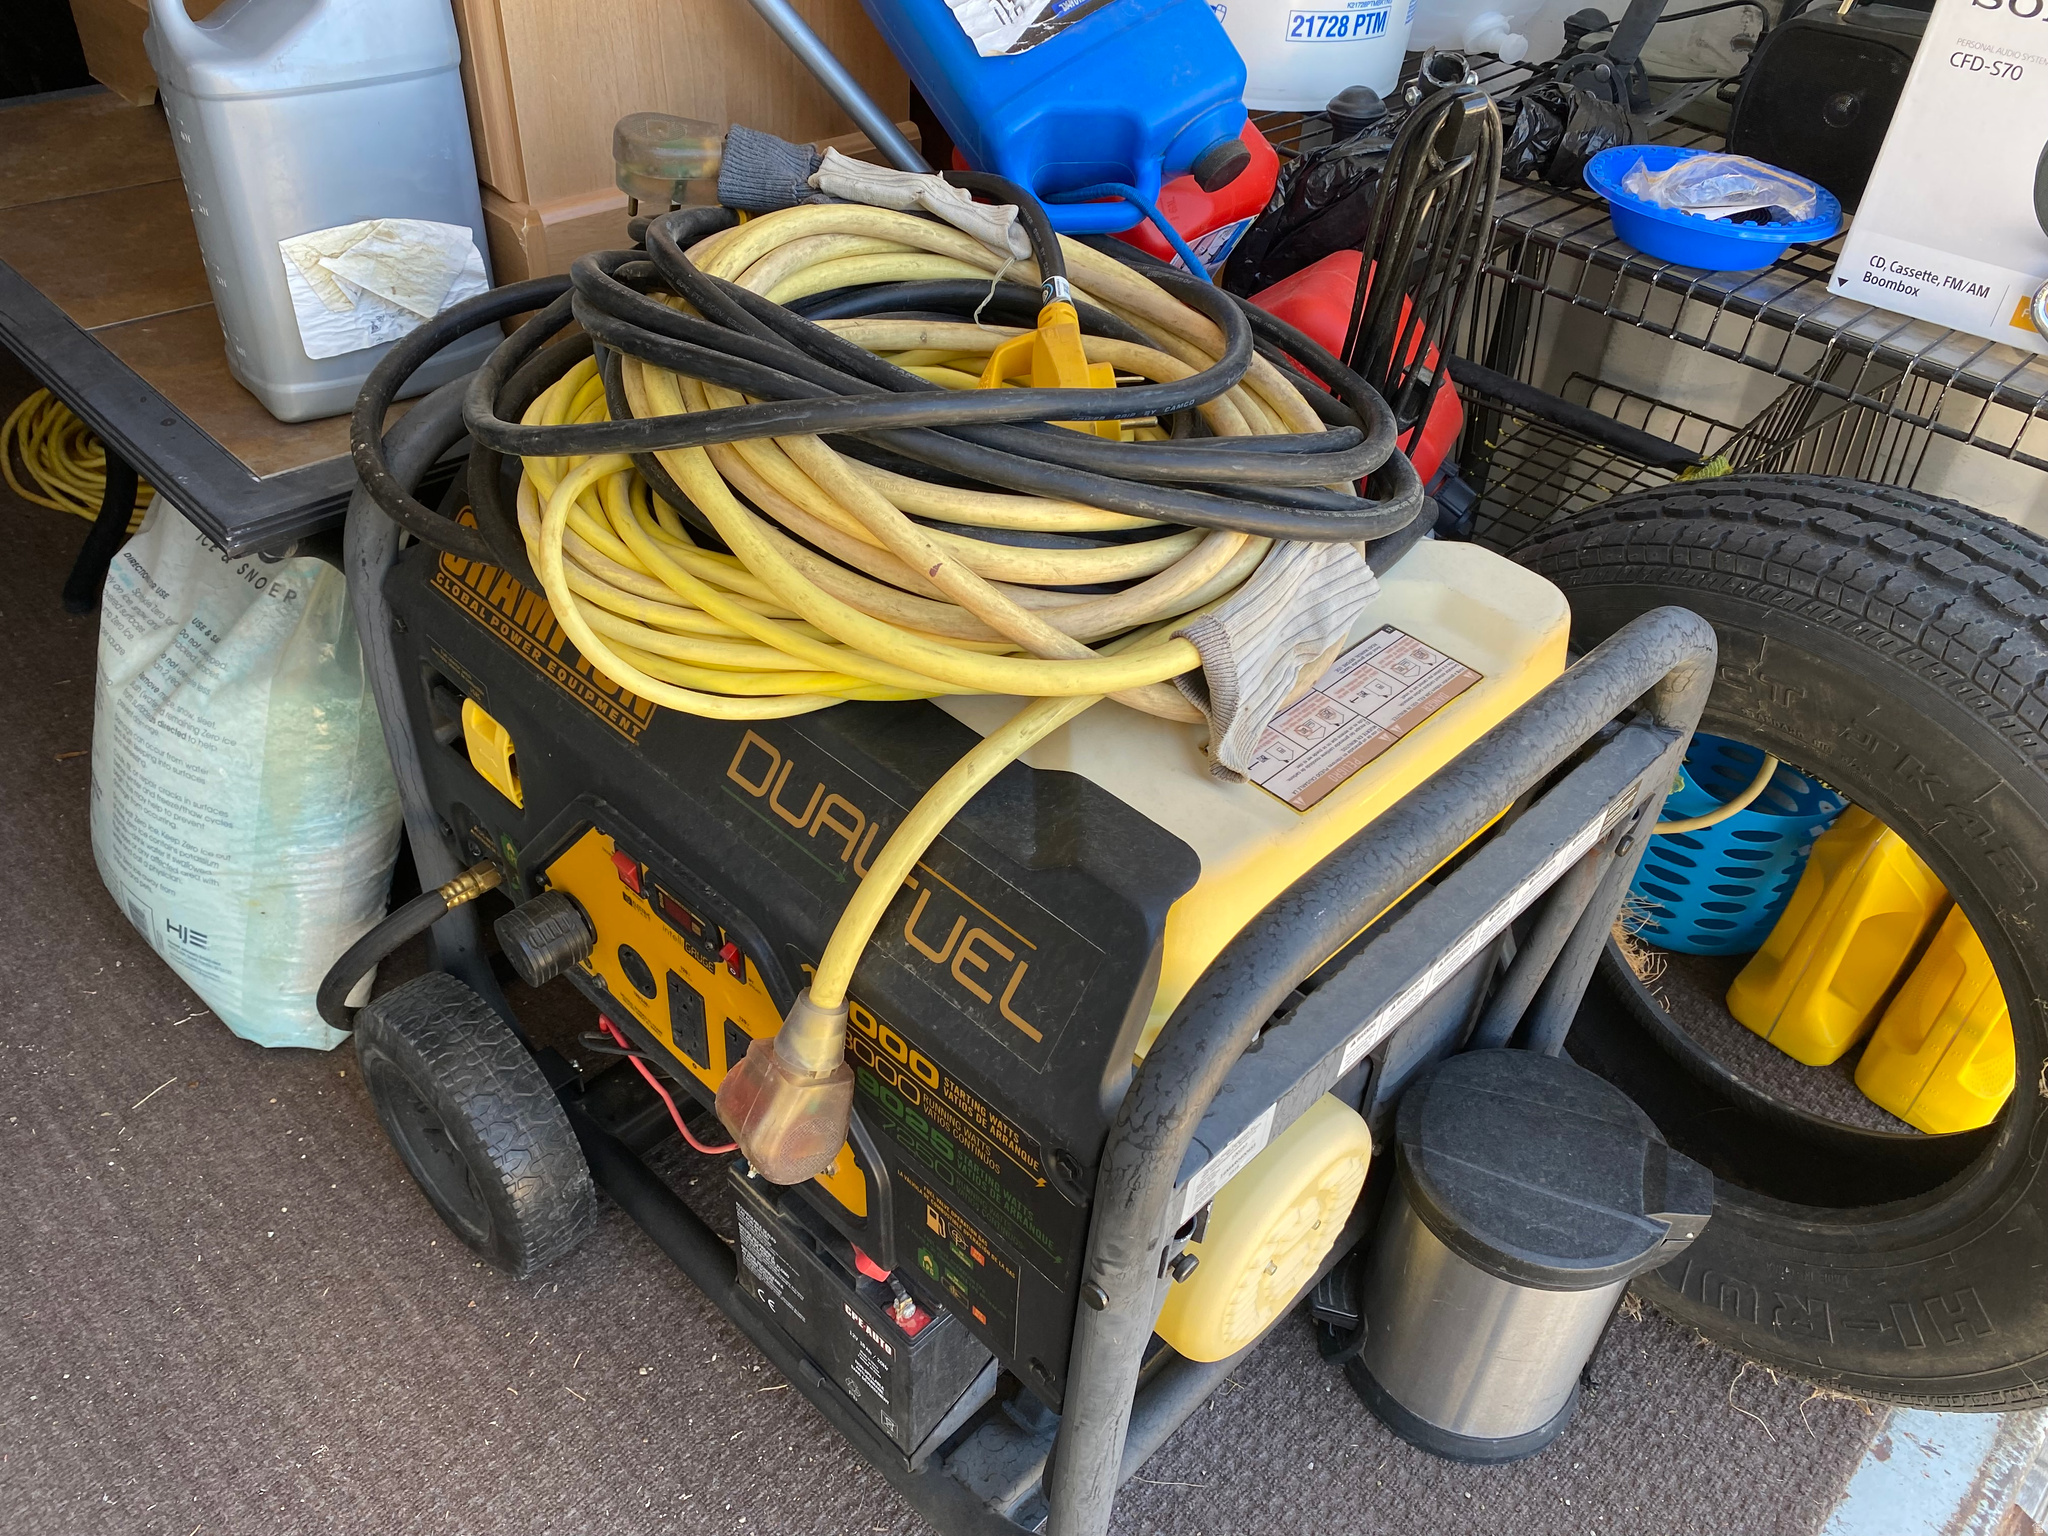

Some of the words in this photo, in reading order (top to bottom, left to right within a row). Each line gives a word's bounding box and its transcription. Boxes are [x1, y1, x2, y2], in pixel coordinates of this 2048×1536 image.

[1291, 15, 1349, 38] 21728
[1352, 11, 1388, 36] PTM
[1956, 38, 1995, 53] PERSONAL
[1995, 48, 2021, 59] AUDIO
[1949, 52, 2023, 81] CFD-S70
[1862, 271, 1921, 297] Boombox
[1869, 255, 1887, 272] CD,
[1889, 261, 1941, 287] Cassette,
[1943, 275, 1991, 299] FM/AM
[1164, 399, 1196, 413] CAMCO
[111, 613, 124, 632] Zero
[192, 617, 206, 631] USE
[180, 629, 189, 639] Do
[188, 637, 202, 649] not
[165, 657, 179, 670] not
[436, 572, 486, 618] GLOBAL
[490, 611, 542, 662] POWER
[547, 661, 640, 737] EQUIPMENT
[1421, 692, 1450, 712] DANGER
[157, 720, 187, 741] directed
[188, 735, 197, 744] to
[198, 738, 218, 752] help
[165, 711, 200, 736] remaining
[200, 729, 220, 742] Zero
[221, 736, 237, 747] Ice
[145, 741, 165, 757] occur
[166, 752, 184, 765] from
[185, 762, 209, 775] water
[158, 757, 171, 770] into
[172, 766, 206, 785] surfaces
[1327, 758, 1362, 781] PELIGRO
[142, 787, 155, 798] and
[157, 794, 203, 819] freeze/thaw
[204, 816, 234, 829] cycles
[147, 800, 163, 812] help
[164, 808, 172, 817] to
[173, 814, 205, 829] prevent
[158, 786, 182, 802] cracks
[184, 796, 192, 805] in
[192, 801, 229, 818] surfaces
[148, 836, 178, 854] contains
[179, 850, 220, 869] potassium
[161, 832, 181, 845] Keep
[181, 841, 199, 853] Zero
[200, 848, 215, 857] Ice
[159, 884, 176, 896] from
[202, 877, 220, 887] with
[726, 729, 880, 881] DUAL
[904, 874, 1043, 1043] UEL
[923, 1094, 961, 1131] RUNNING
[964, 1124, 991, 1155] WATTS
[944, 1077, 986, 1117] STARTING
[989, 1110, 1019, 1143] WATTS
[857, 1066, 954, 1161] 9025
[957, 1151, 1000, 1192] STARTING
[1003, 1188, 1034, 1221] WATTS
[923, 1105, 951, 1133] VATIOS
[953, 1129, 1000, 1174] CONTINUOS
[943, 1088, 973, 1122] VATIOS
[976, 1113, 987, 1129] DE
[990, 1125, 1039, 1172] ARRANQUE
[957, 1161, 987, 1193] VATIOS
[989, 1187, 1001, 1202] DE
[1003, 1200, 1055, 1250] ARRANQUE
[950, 1209, 978, 1238] OPERATION
[758, 1288, 776, 1313] CE
[1681, 1258, 1997, 1349] HI-RU
